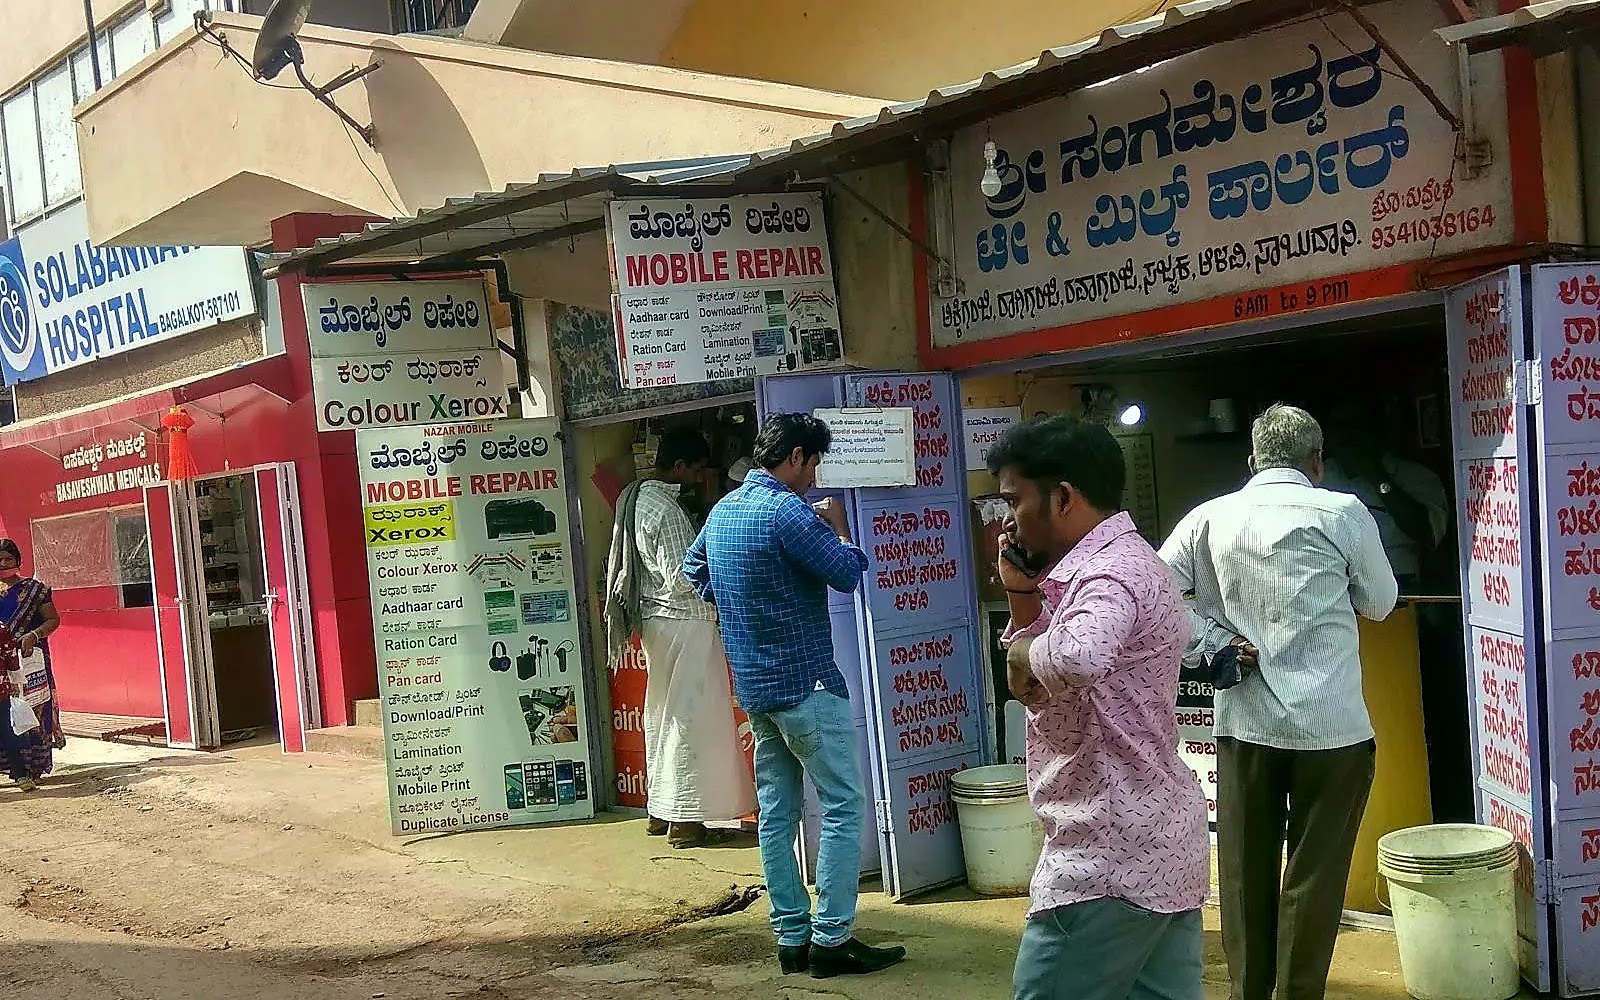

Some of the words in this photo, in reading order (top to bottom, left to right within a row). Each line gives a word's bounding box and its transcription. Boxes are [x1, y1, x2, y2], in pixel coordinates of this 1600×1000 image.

[628, 202, 732, 252] ಮೊಬೈಲ್
[746, 202, 811, 234] ರಿಪೇರಿ
[1371, 204, 1496, 249] 9341038164
[976, 221, 1030, 273] ಟೀ
[1045, 211, 1072, 257] &
[626, 251, 730, 287] MOBILE
[736, 246, 825, 280] REPAIR
[700, 304, 763, 317] Download/Print
[1280, 291, 1298, 311] to
[159, 290, 241, 333] BAGALKOT-587101
[319, 296, 411, 347] ಮೊಬೈಲ್
[423, 294, 480, 329] ರಿಪೇರಿ
[629, 312, 667, 323] Aadhaar
[669, 309, 689, 320] card
[46, 287, 159, 367] HOSPITAL
[632, 344, 663, 355] Ration
[665, 341, 686, 352] Card
[703, 336, 749, 348] Lamination
[636, 377, 653, 387] Pan
[656, 374, 677, 384] card
[706, 368, 734, 379] Mobile
[736, 365, 757, 376] Print
[324, 399, 420, 427] Colour
[428, 393, 505, 419] Xerox
[423, 426, 455, 437] NAZAR
[457, 424, 493, 434] MOBILE
[370, 438, 466, 476] ಮೊಬೈಲ್
[480, 434, 549, 459] ರಿಪೇರಿ
[56, 473, 116, 503] BASAVESHWAR
[116, 463, 161, 490] MEDICALS
[367, 476, 462, 503] MOBILE
[470, 469, 559, 495] REPAIR
[369, 525, 447, 543] Xerox
[378, 565, 419, 578] Colour
[422, 563, 458, 575] Xerox
[381, 601, 432, 615] Aadhaar
[436, 597, 463, 610] card
[385, 638, 424, 651] Ration
[428, 634, 457, 647] Card
[388, 675, 410, 687] Pan
[414, 672, 441, 685] card
[391, 705, 484, 723] Download/Print
[613, 703, 645, 732] airt
[394, 744, 462, 759] Lamination
[397, 781, 437, 796] Mobile
[441, 779, 471, 792] Print
[618, 766, 648, 795] airt
[401, 816, 458, 832] Duplicate
[462, 812, 509, 825] License
